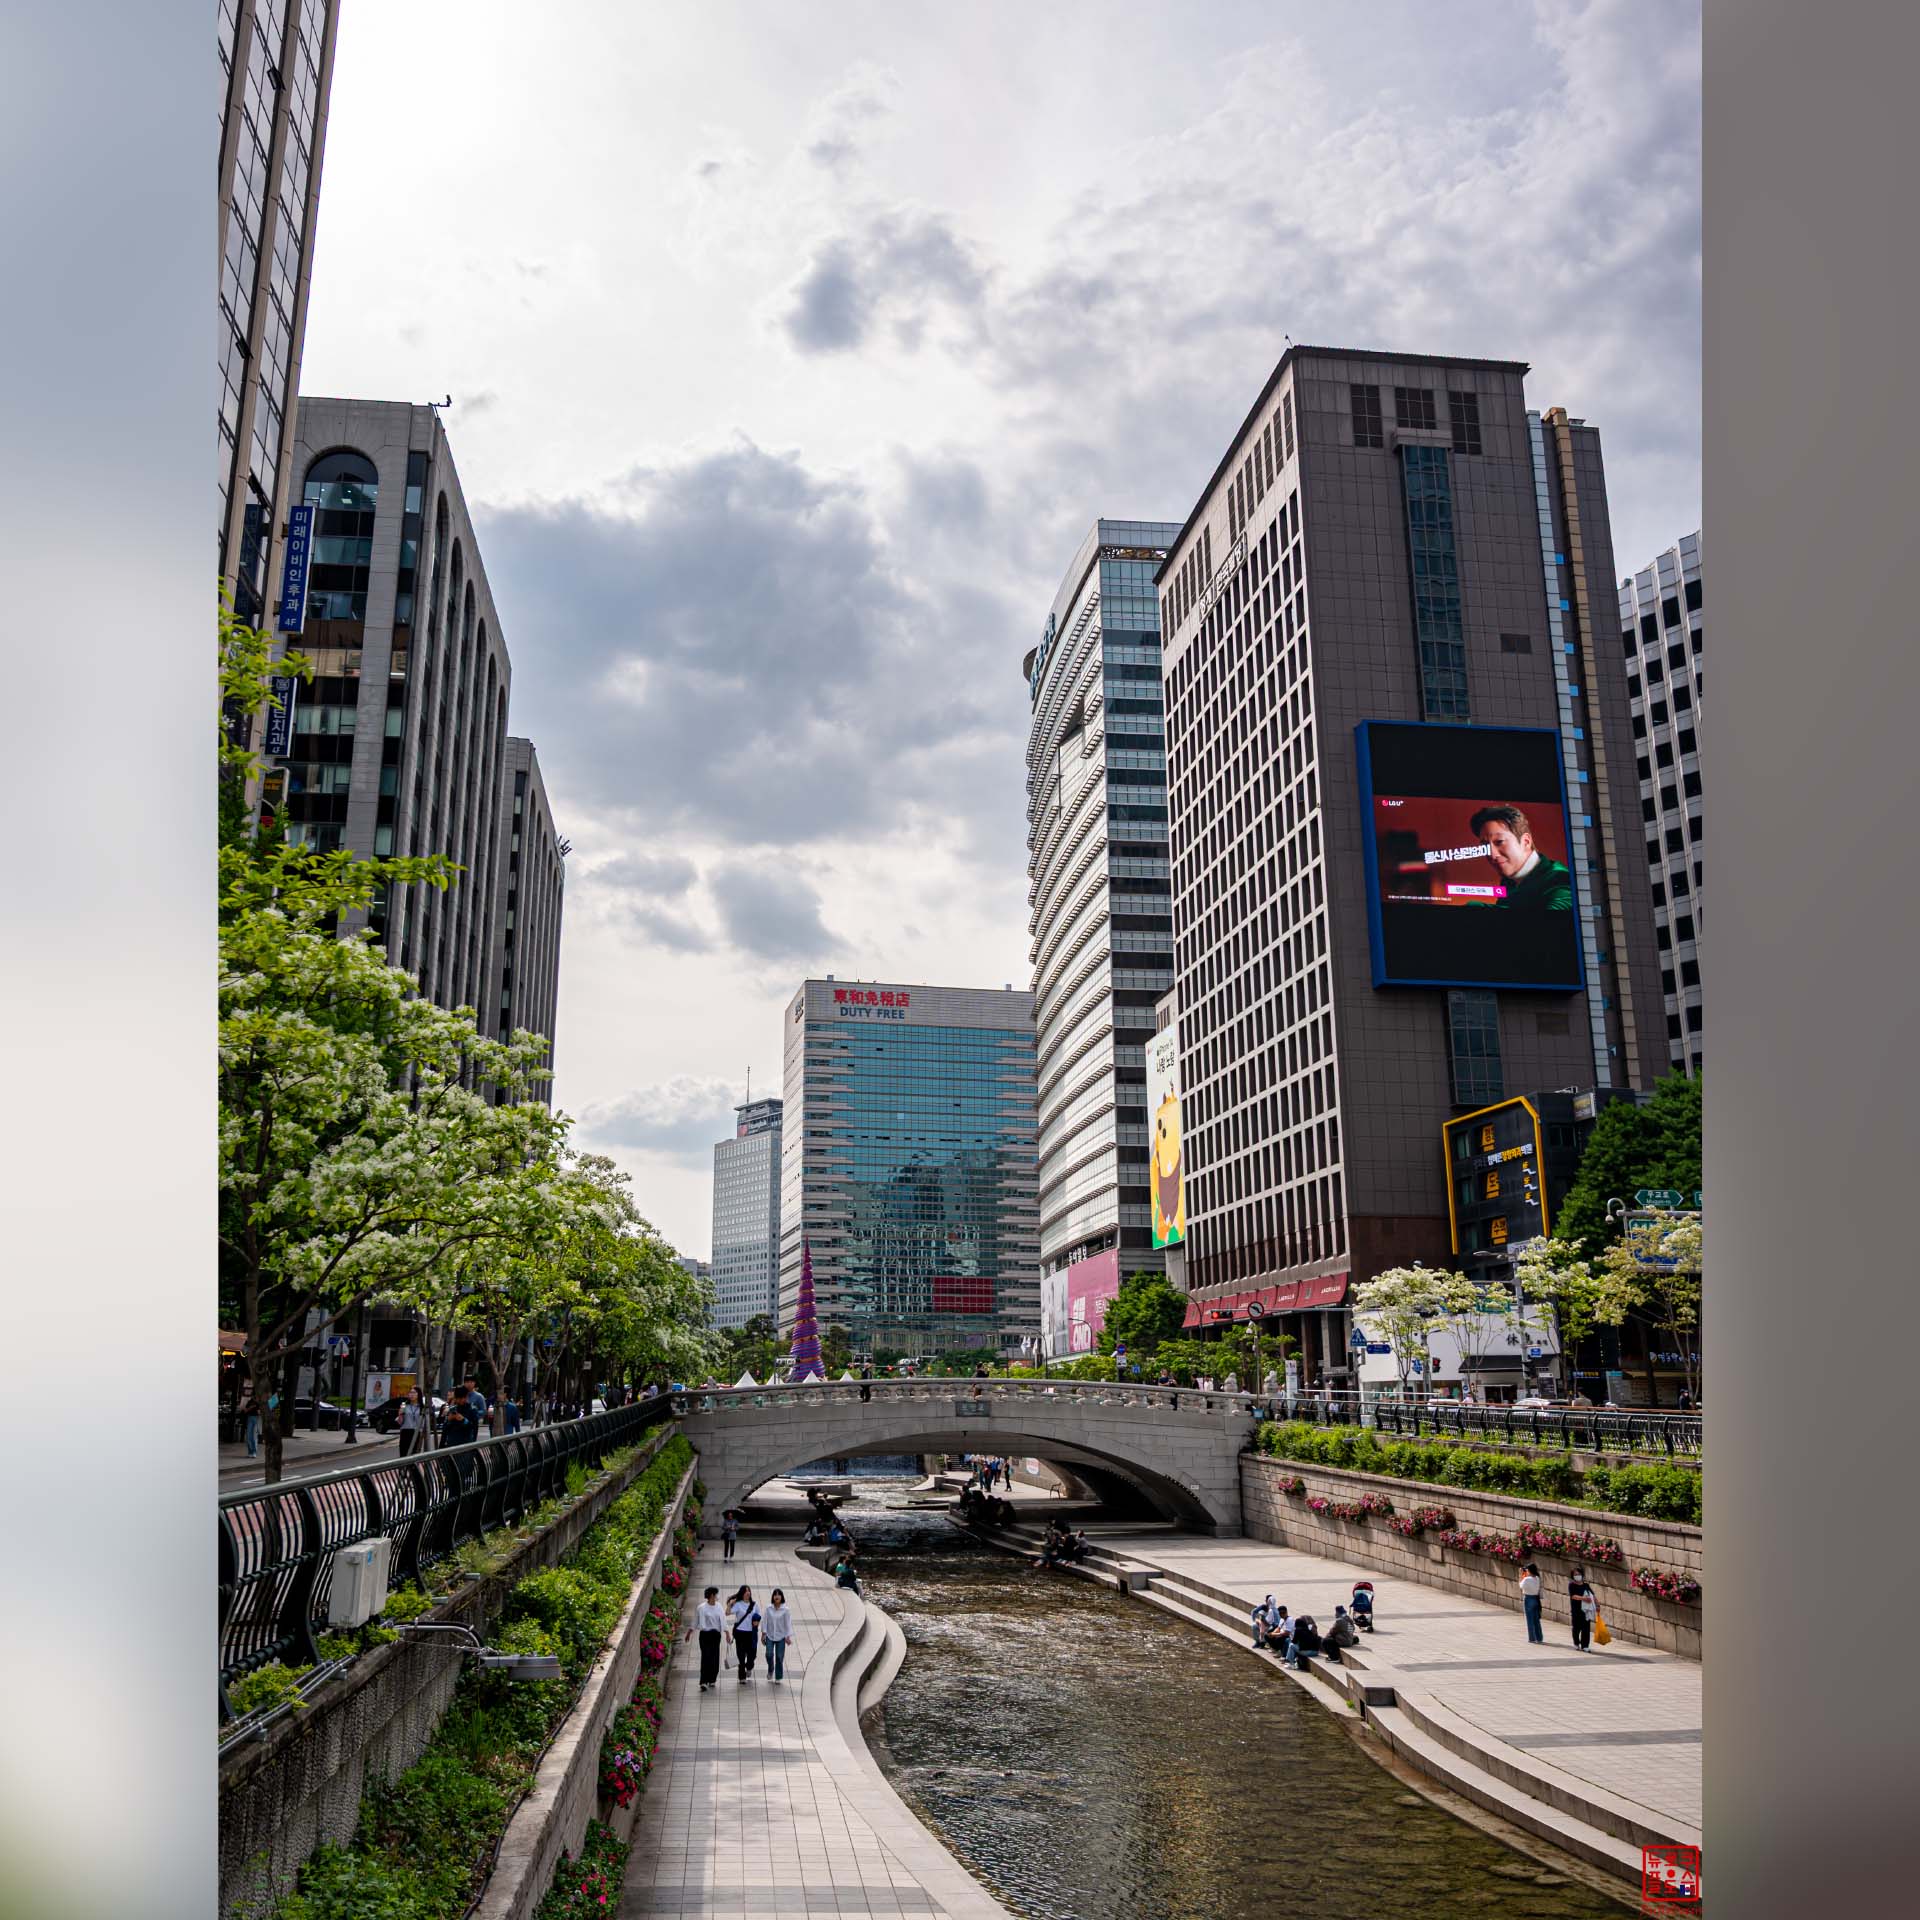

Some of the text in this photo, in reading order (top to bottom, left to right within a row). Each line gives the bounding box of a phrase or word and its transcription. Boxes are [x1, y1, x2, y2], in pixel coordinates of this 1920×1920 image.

[285, 510, 308, 614] 미래이비인후과
[284, 617, 297, 627] 4F
[840, 1006, 906, 1020] DUTY FREE
